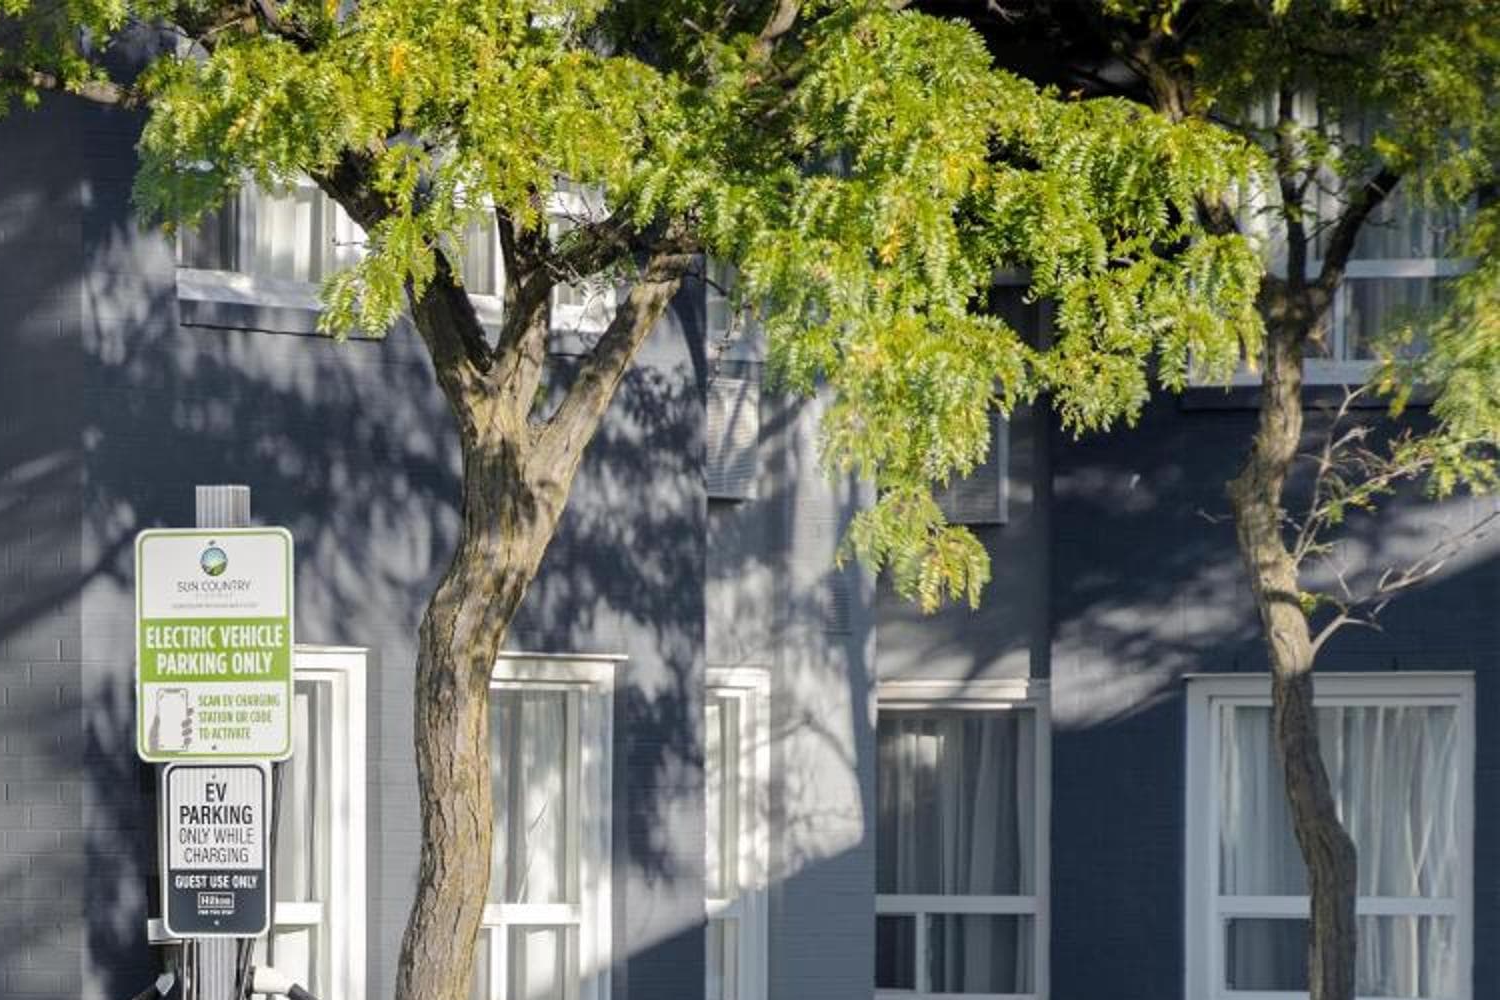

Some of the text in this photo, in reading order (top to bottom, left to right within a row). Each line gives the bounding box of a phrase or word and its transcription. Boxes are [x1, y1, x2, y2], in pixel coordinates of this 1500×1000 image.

[177, 580, 251, 592] SUN COUNTRY
[146, 625, 284, 648] ELECTRIC VEHICLE
[157, 652, 274, 675] PARKING ONLY
[198, 695, 220, 706] SCAN
[223, 695, 234, 706] EV
[198, 711, 233, 722] STATION
[250, 710, 272, 722] CODE
[199, 727, 250, 740] TO ACTIVATE
[206, 783, 227, 802] EV
[180, 805, 253, 825] PARKING
[180, 828, 255, 845] ONLY WHILE
[184, 847, 249, 864] CHARGING
[175, 875, 258, 888] GUEST USE ONLY
